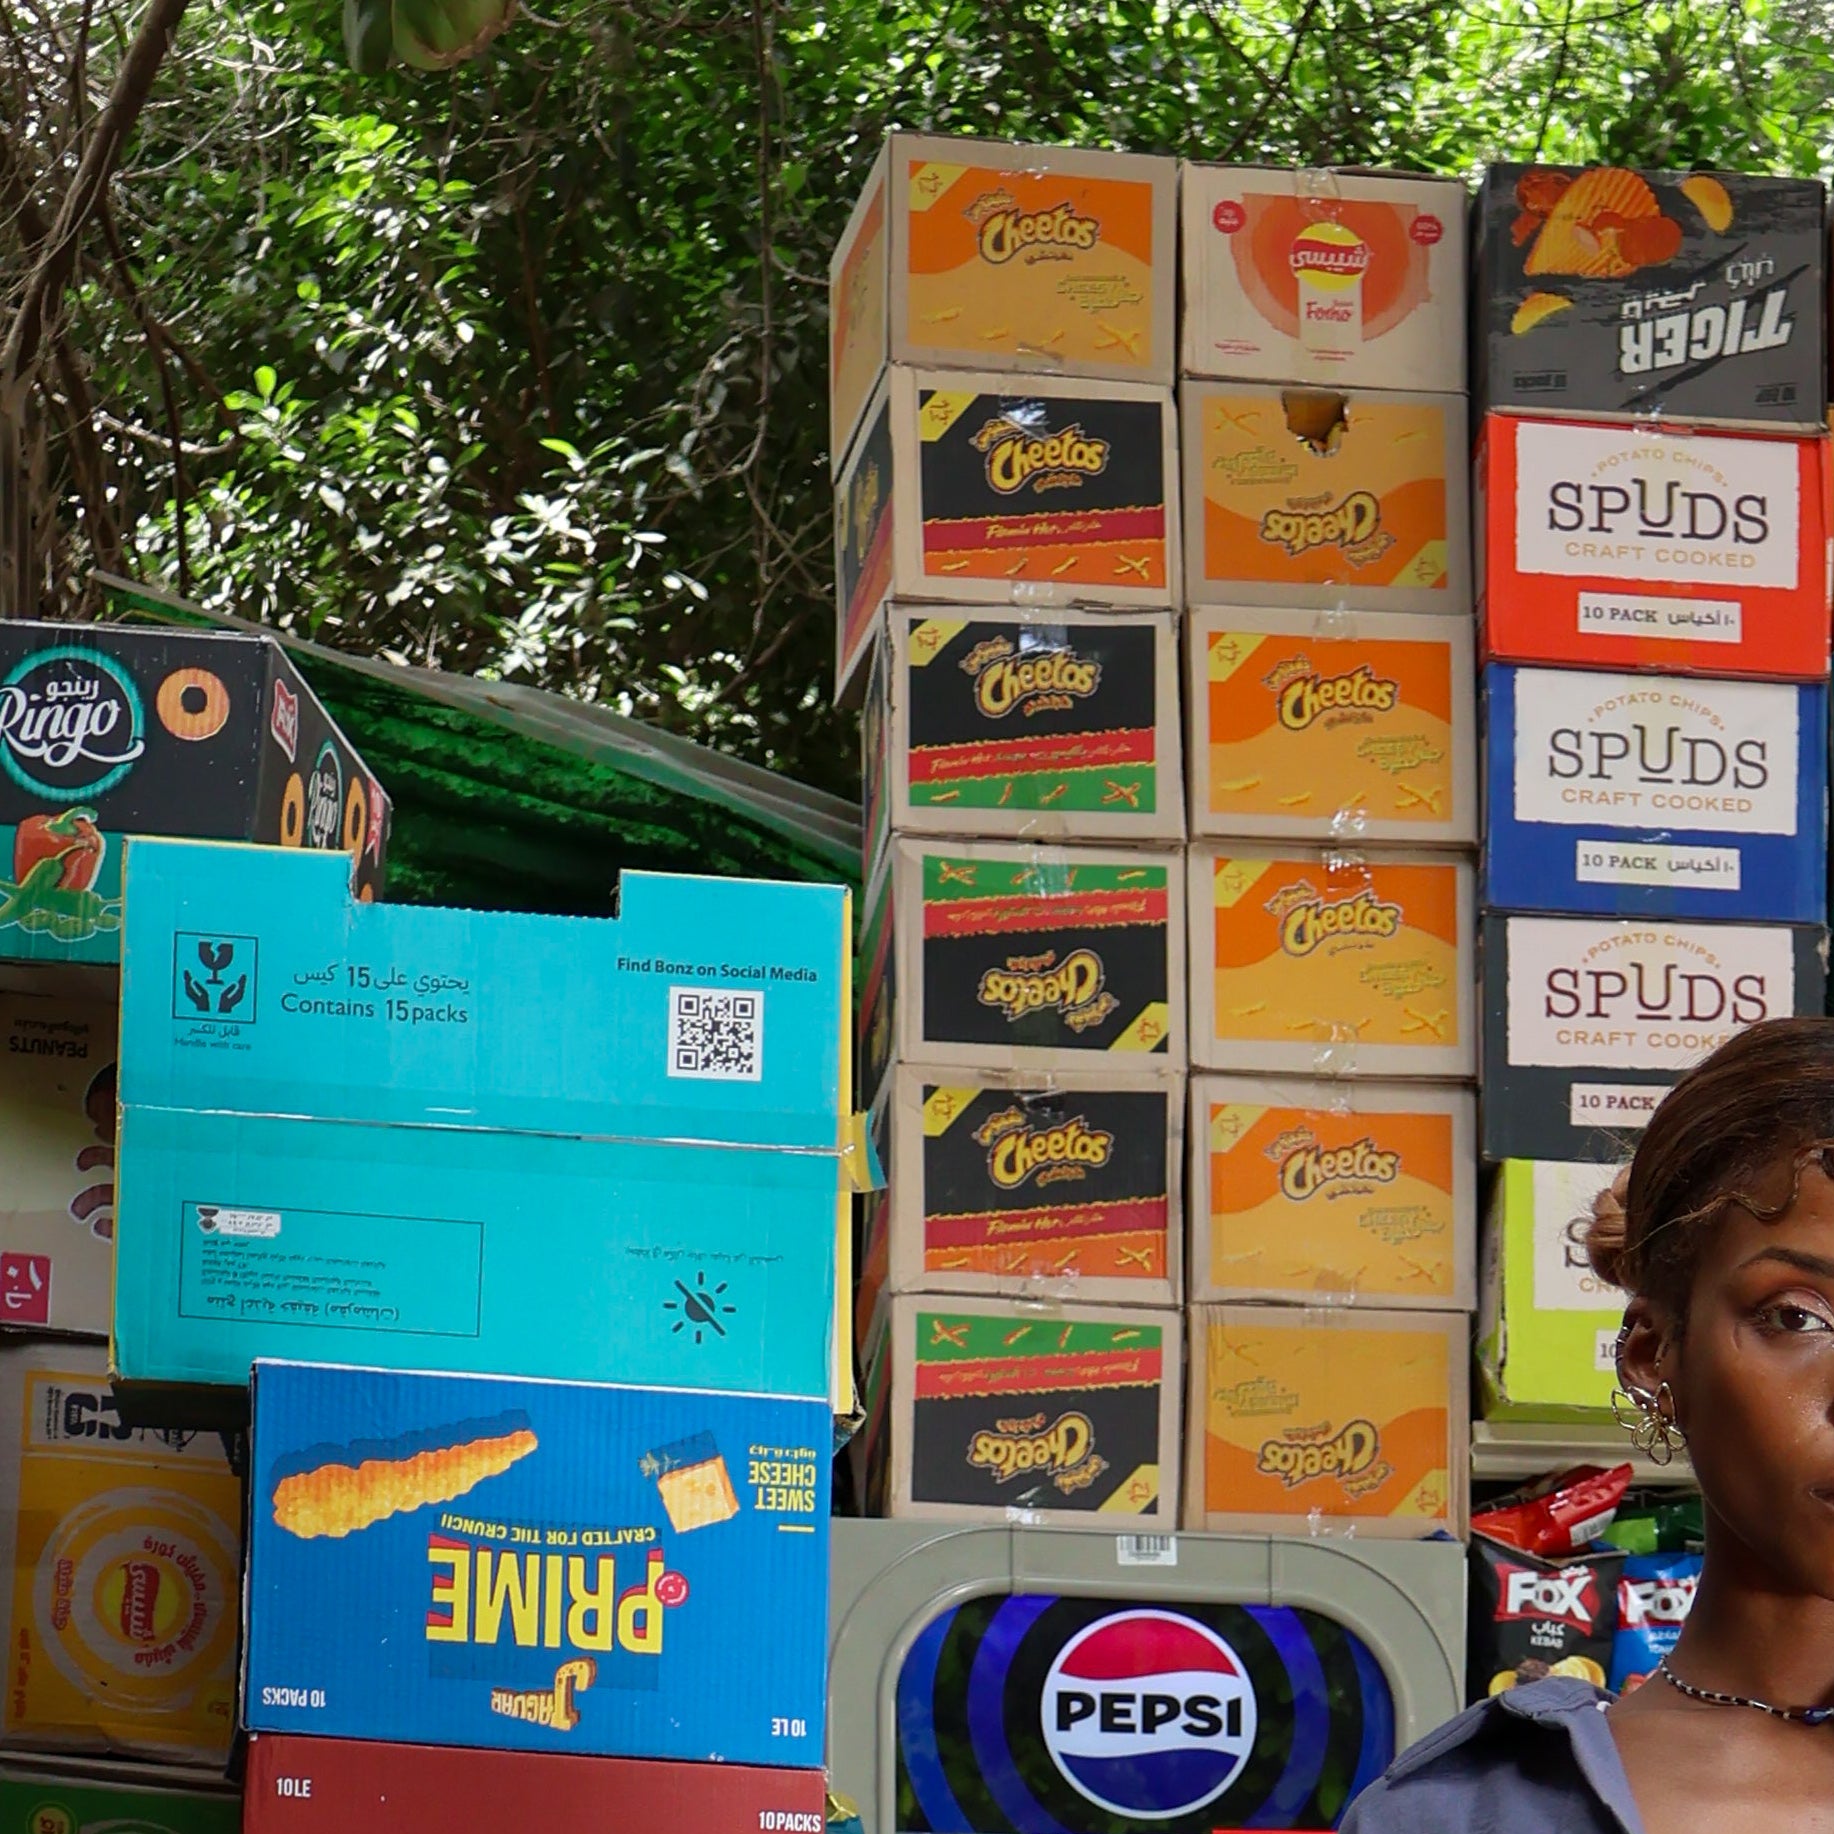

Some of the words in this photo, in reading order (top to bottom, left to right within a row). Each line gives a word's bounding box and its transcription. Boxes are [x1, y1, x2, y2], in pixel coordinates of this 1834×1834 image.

[979, 204, 1100, 263] Cheetos
[1620, 289, 1795, 375] TIGER
[985, 432, 1108, 494] Cheetos
[1598, 449, 1666, 478] POTATO
[1672, 451, 1723, 486] CHIPS
[1549, 479, 1768, 547] SPUDS
[1565, 542, 1639, 562] CRAFT
[1650, 545, 1756, 569] COOKED
[1582, 606, 1602, 622] 10
[1609, 606, 1657, 625] PACK
[46, 676, 98, 701] رينجو
[1277, 668, 1398, 731] Cheetos
[1594, 693, 1661, 722] POTATO
[1668, 694, 1720, 729] CHIPS
[0, 687, 144, 767] Ringo
[1549, 724, 1768, 790] SPUDS
[1561, 788, 1640, 807] CRAFT
[1651, 792, 1751, 813] COOKED
[1582, 854, 1602, 870] 10
[1609, 854, 1657, 872] PACK
[294, 964, 338, 985] كيس
[348, 966, 370, 988] 15
[374, 968, 408, 990] على
[617, 957, 651, 973] Find
[655, 960, 694, 976] Bonz
[697, 965, 717, 977] on
[721, 963, 766, 980] Social
[770, 965, 818, 982] Media
[414, 975, 469, 997] يحتوي
[978, 949, 1103, 1021] Cheetos
[1545, 963, 1767, 1025] SPUDS
[281, 994, 374, 1017] Contains
[386, 1000, 409, 1021] 15
[412, 1004, 468, 1025] packs
[989, 1120, 1113, 1188] Cheetos
[1260, 1420, 1381, 1487] Cheetos
[748, 1462, 816, 1487] CHEESE
[755, 1487, 816, 1512] SWEET
[440, 1514, 507, 1541] CRUNCH
[512, 1526, 542, 1543] THE
[547, 1528, 579, 1548] FOR
[582, 1527, 656, 1547] CRAFTED
[426, 1535, 665, 1656] PRIME
[1506, 1571, 1594, 1621] FOX
[262, 1687, 307, 1706] PACKS
[310, 1689, 327, 1708] 10
[492, 1657, 595, 1731] JAGUAR
[1056, 1690, 1243, 1737] PEPSI
[771, 1718, 788, 1737] LE
[790, 1718, 807, 1738] 10
